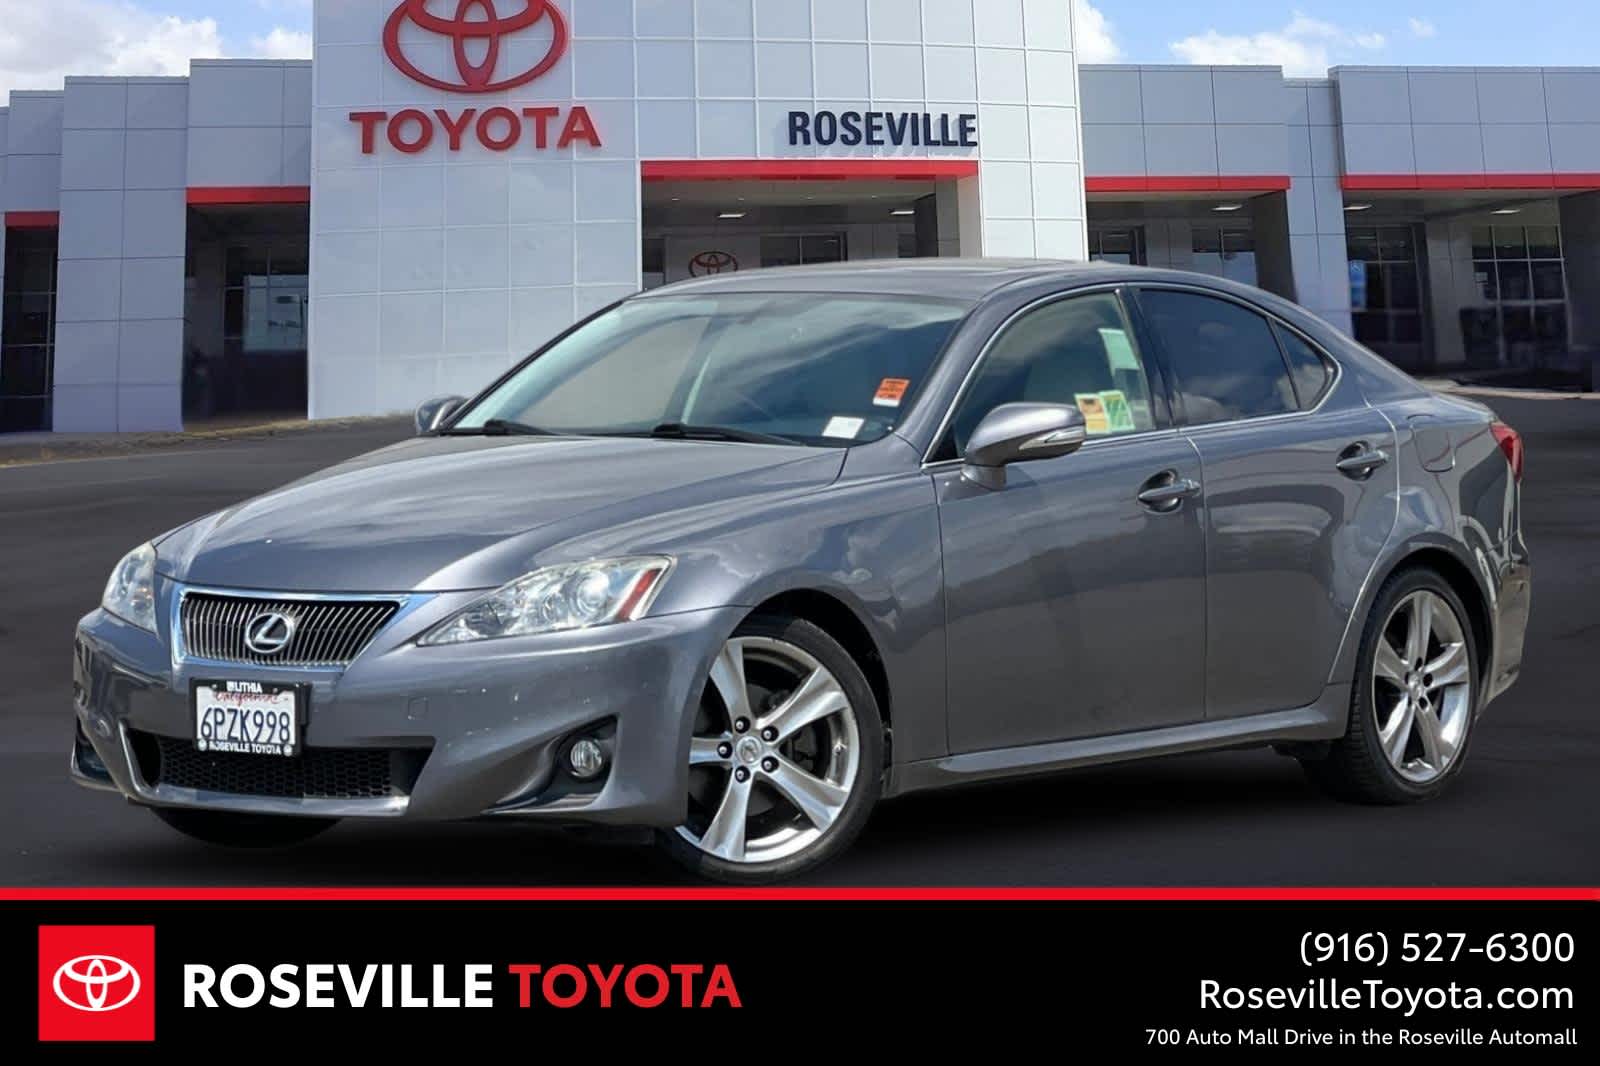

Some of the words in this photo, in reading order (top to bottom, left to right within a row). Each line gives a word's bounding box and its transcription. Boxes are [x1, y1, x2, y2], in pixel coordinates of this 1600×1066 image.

[349, 106, 602, 154] TOYOTA
[788, 111, 978, 147] ROSEVILLE
[234, 681, 263, 693] LITHIA
[201, 707, 290, 743] 6PZK998
[251, 743, 282, 755] TOYOTA
